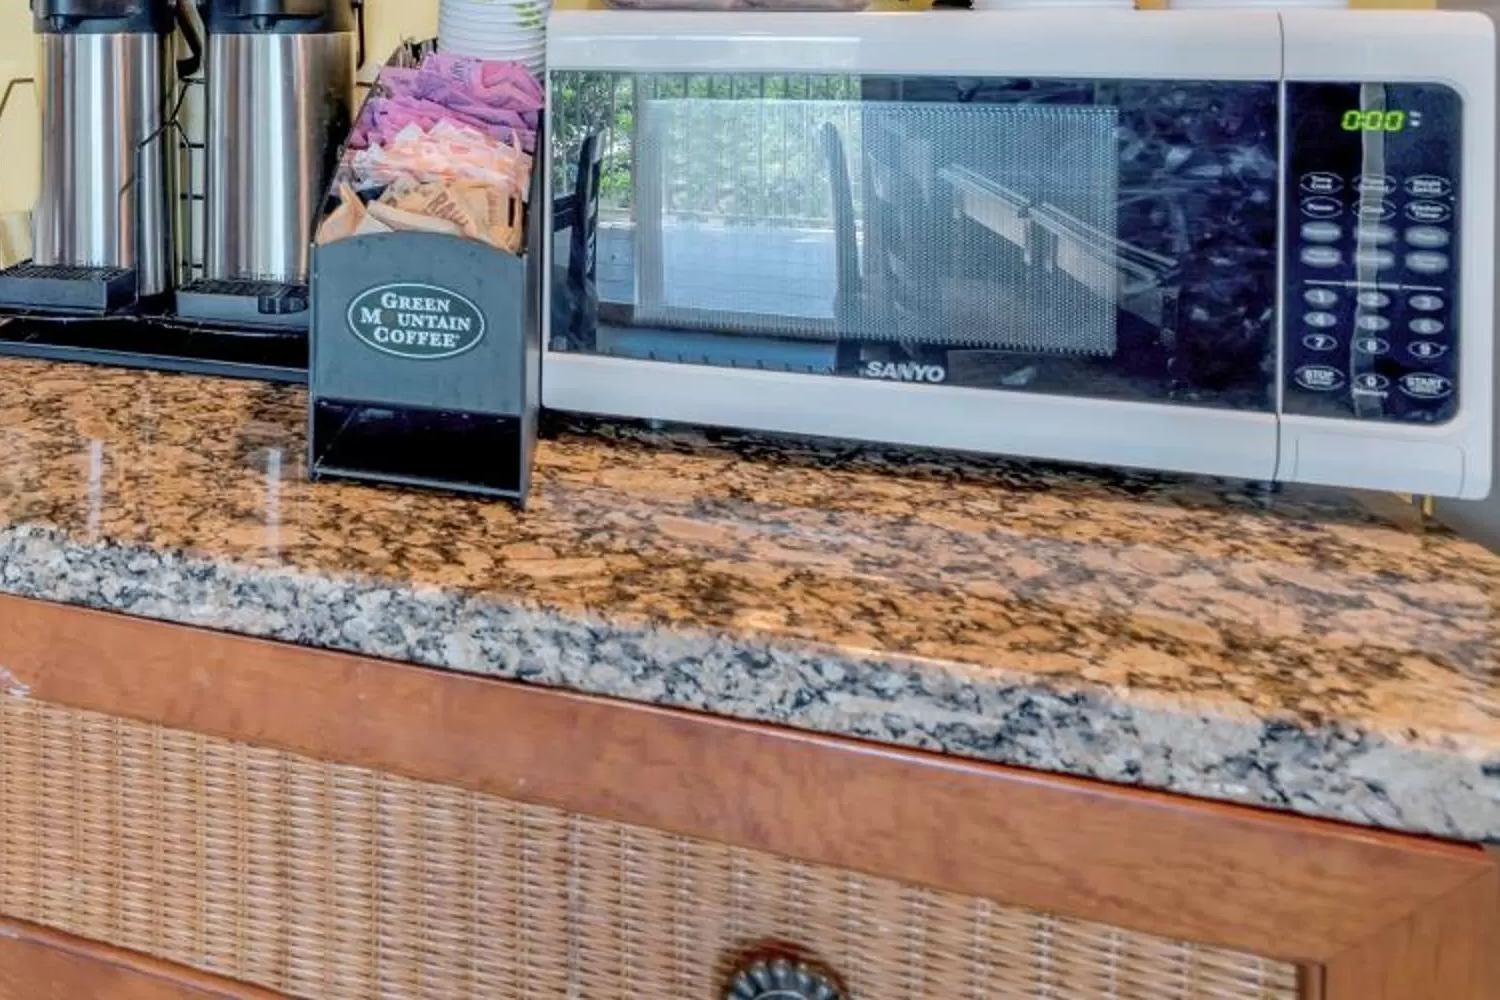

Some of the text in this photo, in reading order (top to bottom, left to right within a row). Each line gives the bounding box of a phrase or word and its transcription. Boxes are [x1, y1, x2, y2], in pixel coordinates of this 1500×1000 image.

[1342, 110, 1405, 131] 0:00
[380, 292, 451, 313] GREEN
[373, 326, 457, 348] COFFEE
[866, 361, 946, 383] SANYO
[1366, 375, 1377, 387] 0
